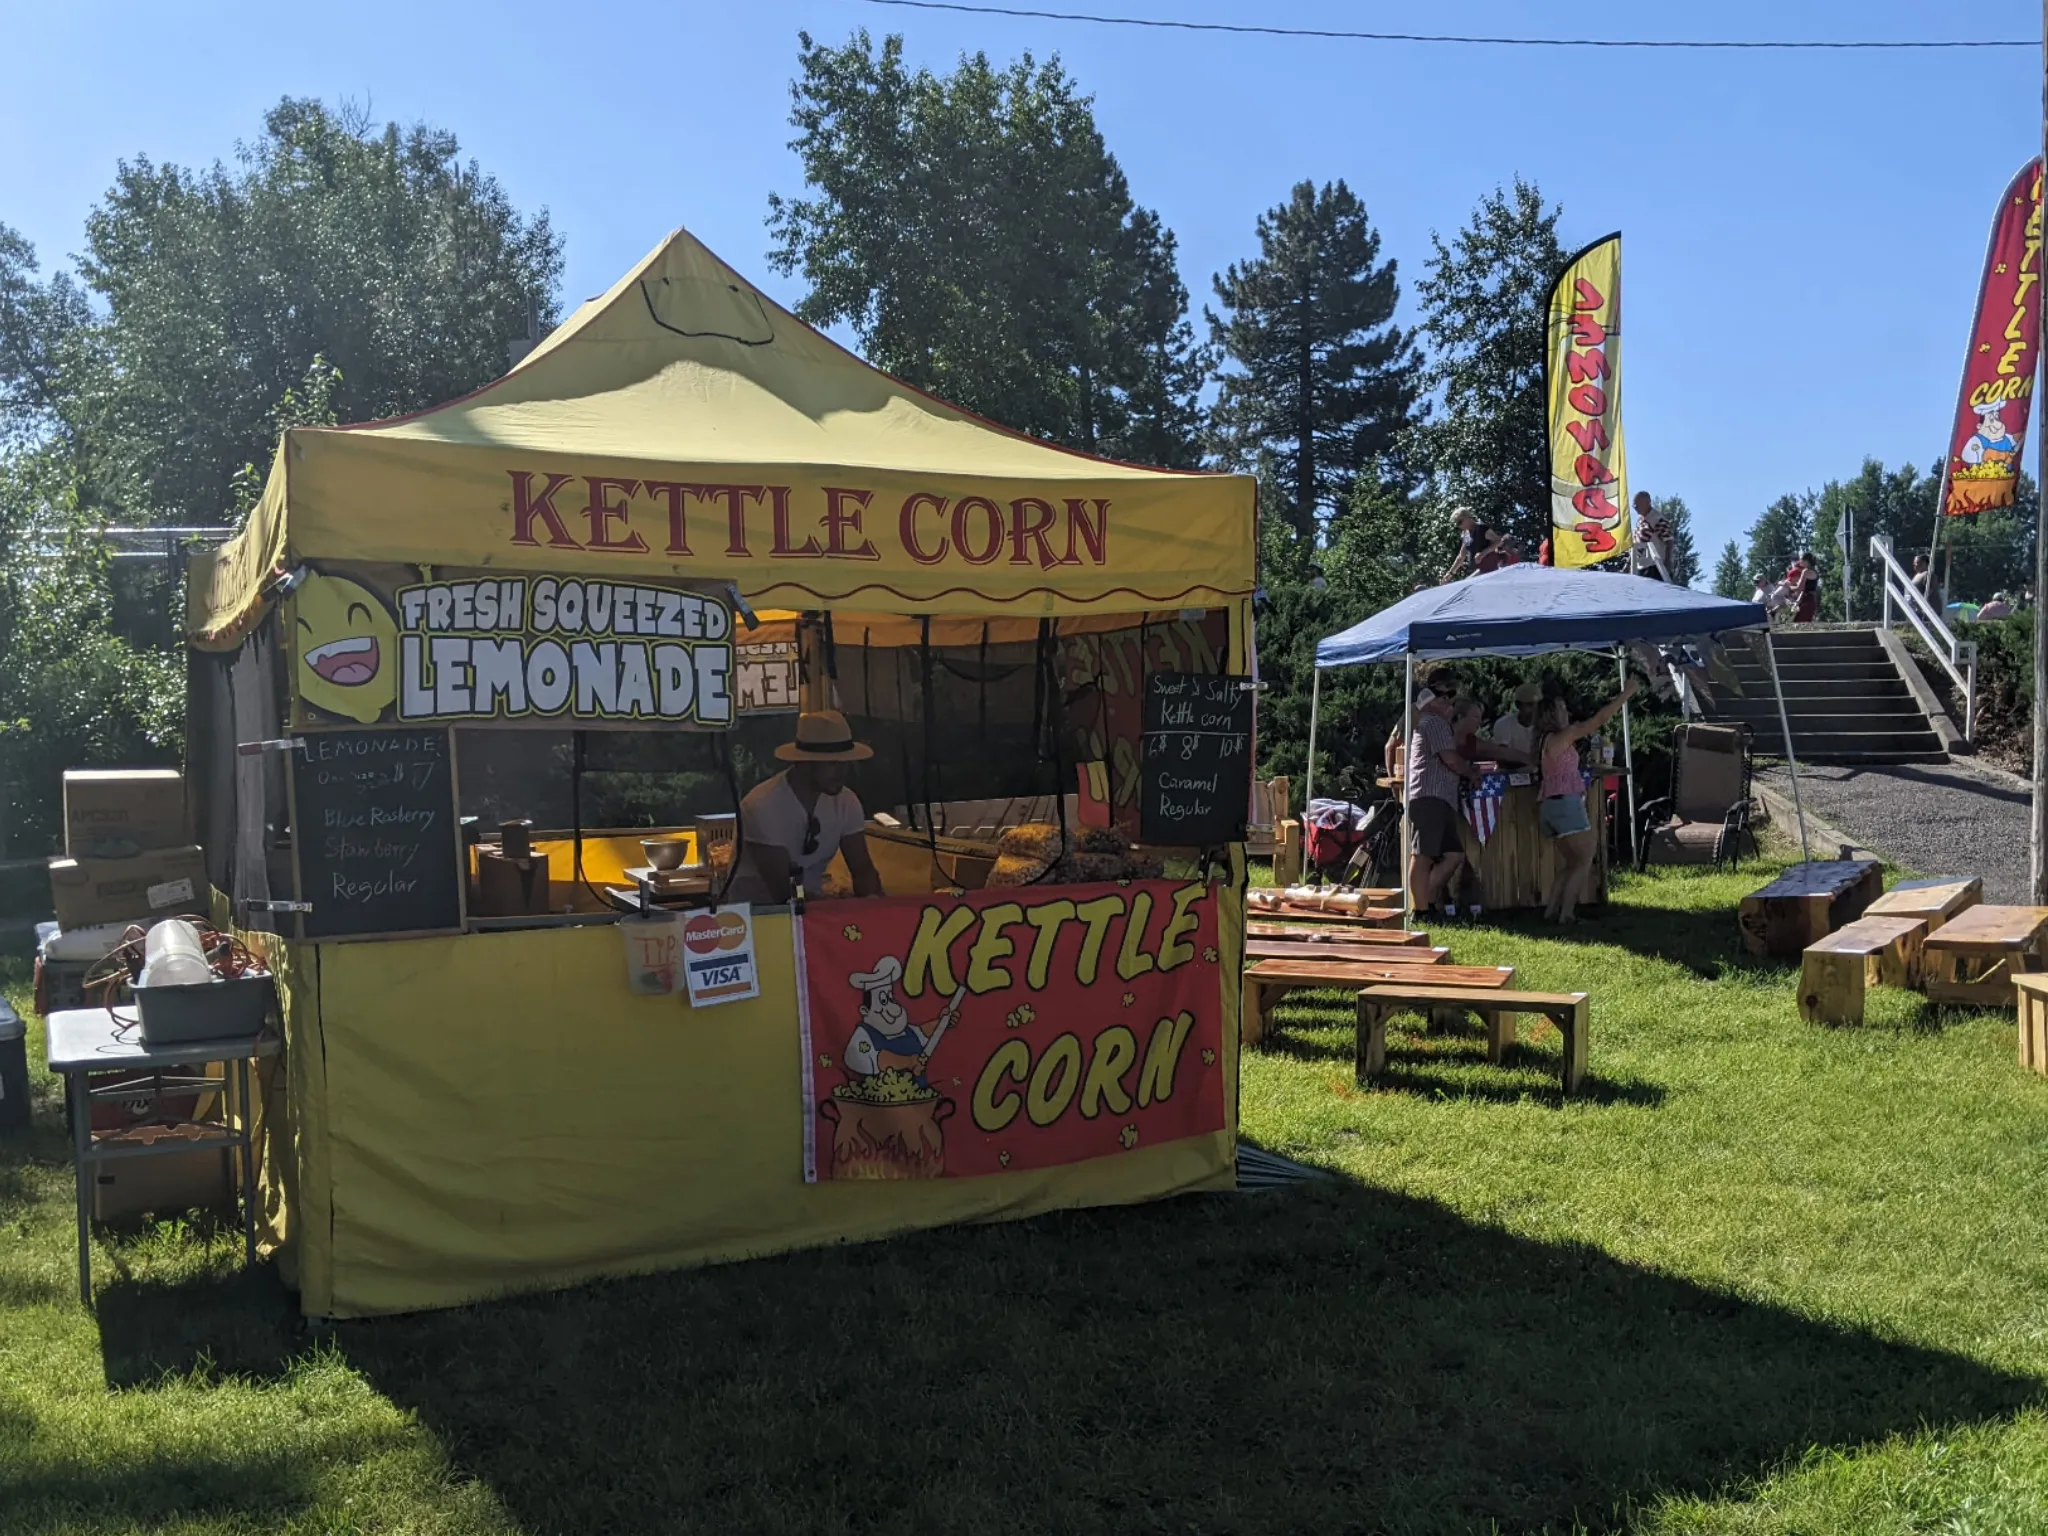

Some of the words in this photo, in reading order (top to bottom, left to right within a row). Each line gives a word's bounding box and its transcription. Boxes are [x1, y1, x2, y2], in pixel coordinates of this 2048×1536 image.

[506, 469, 880, 561] KETTLE
[898, 491, 1114, 572] CORN
[401, 580, 526, 632] FRESH
[533, 576, 728, 640] SQUEEZED
[402, 636, 731, 720] LEMONADE
[1204, 679, 1243, 712] Salty
[1200, 713, 1232, 731] corn
[1158, 771, 1218, 794] Caramel
[324, 807, 367, 828] Blue
[1159, 791, 1211, 821] Regular
[332, 870, 418, 903] Regular
[685, 924, 746, 942] MasterCard
[902, 886, 1209, 998] KETTLE
[701, 966, 741, 987] VISA
[970, 1010, 1195, 1132] CORN
